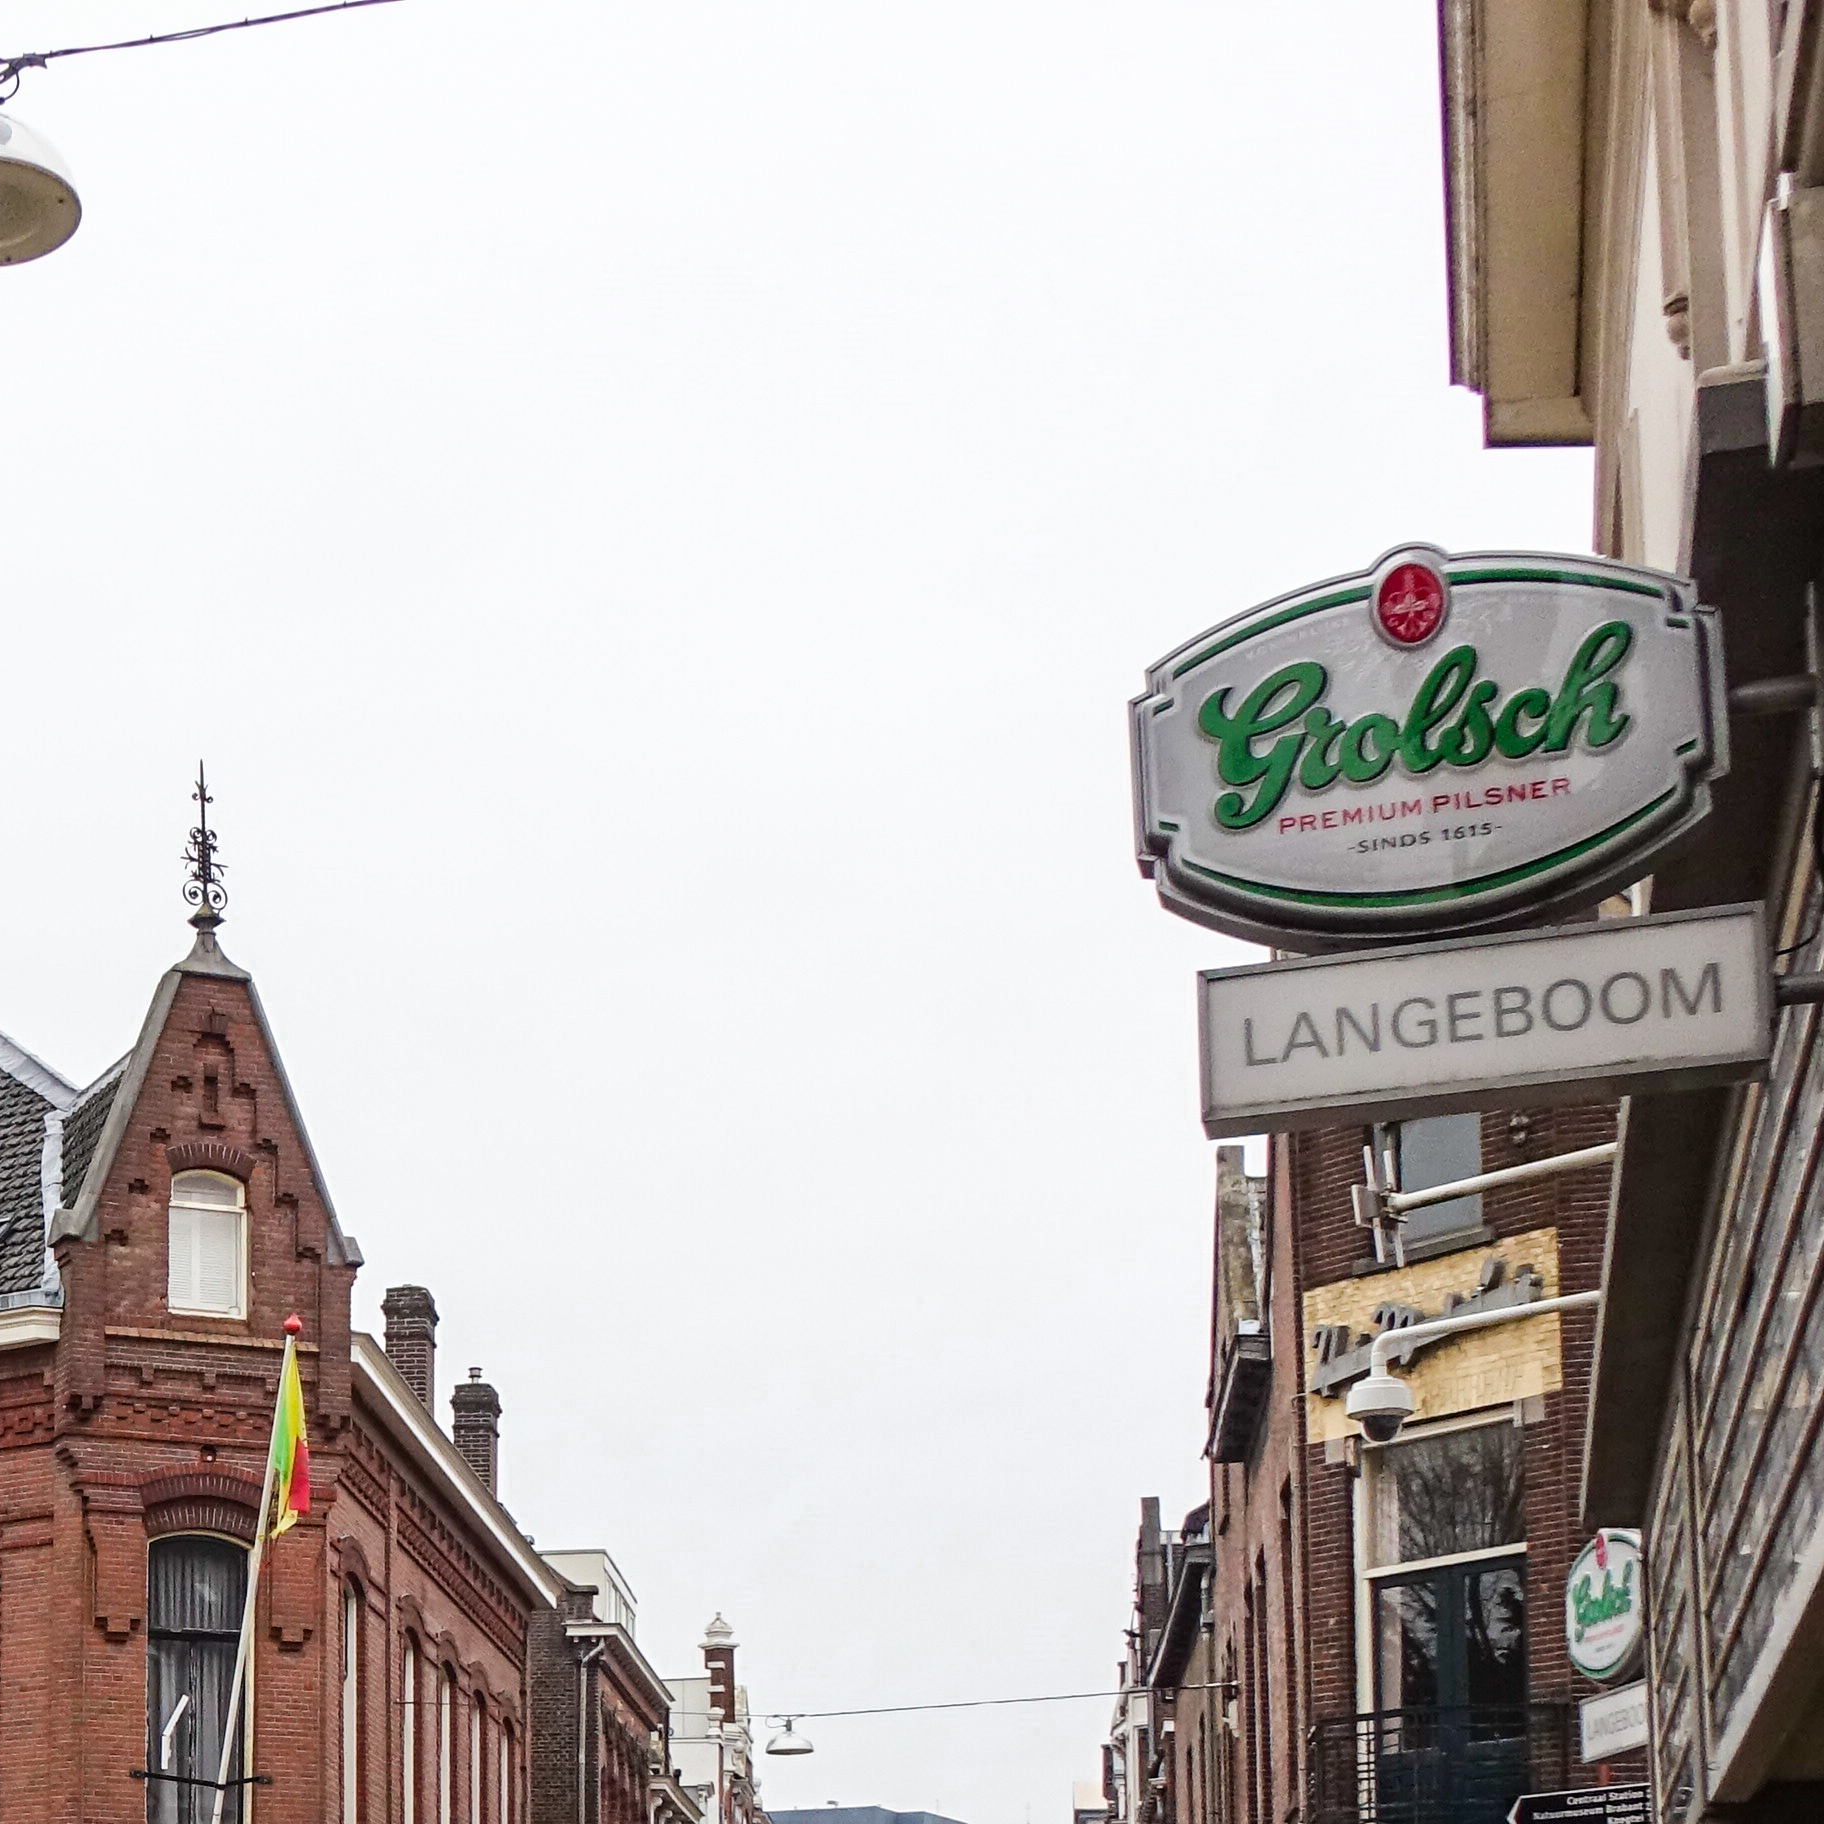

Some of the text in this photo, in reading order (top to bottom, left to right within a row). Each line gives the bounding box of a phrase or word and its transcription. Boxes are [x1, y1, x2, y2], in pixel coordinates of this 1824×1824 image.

[1198, 621, 1631, 829] Grolsch
[1279, 778, 1571, 835] PREMIUM PILSNER
[1243, 962, 1724, 1067] LANGEBOOM
[1567, 1790, 1644, 1806] Centraal Station
